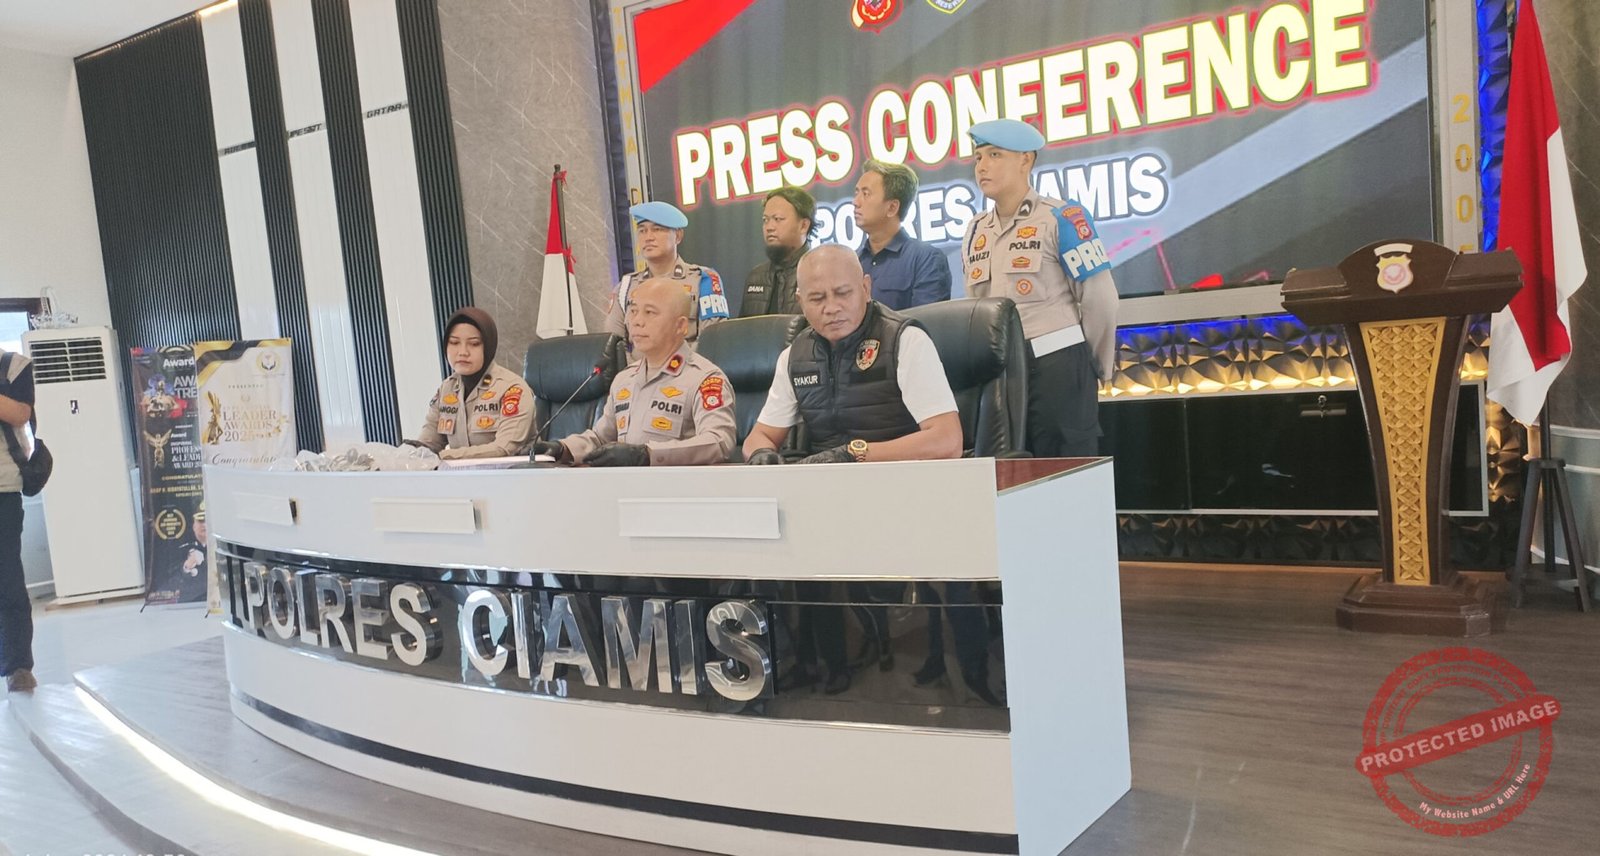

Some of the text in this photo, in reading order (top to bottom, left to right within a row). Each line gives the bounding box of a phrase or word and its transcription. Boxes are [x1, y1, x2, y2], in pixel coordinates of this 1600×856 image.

[676, 0, 1370, 206] PRESS CONFERENCE
[1453, 93, 1474, 249] 200
[985, 152, 1165, 217] AMIS
[1009, 241, 1041, 251] POLRI
[793, 375, 819, 386] SYAKUR
[474, 403, 499, 412] POLRI
[651, 400, 682, 415] POLRI
[223, 410, 277, 421] LEADER
[223, 421, 273, 430] AWARDS
[243, 561, 773, 701] POLRES CIAMIS
